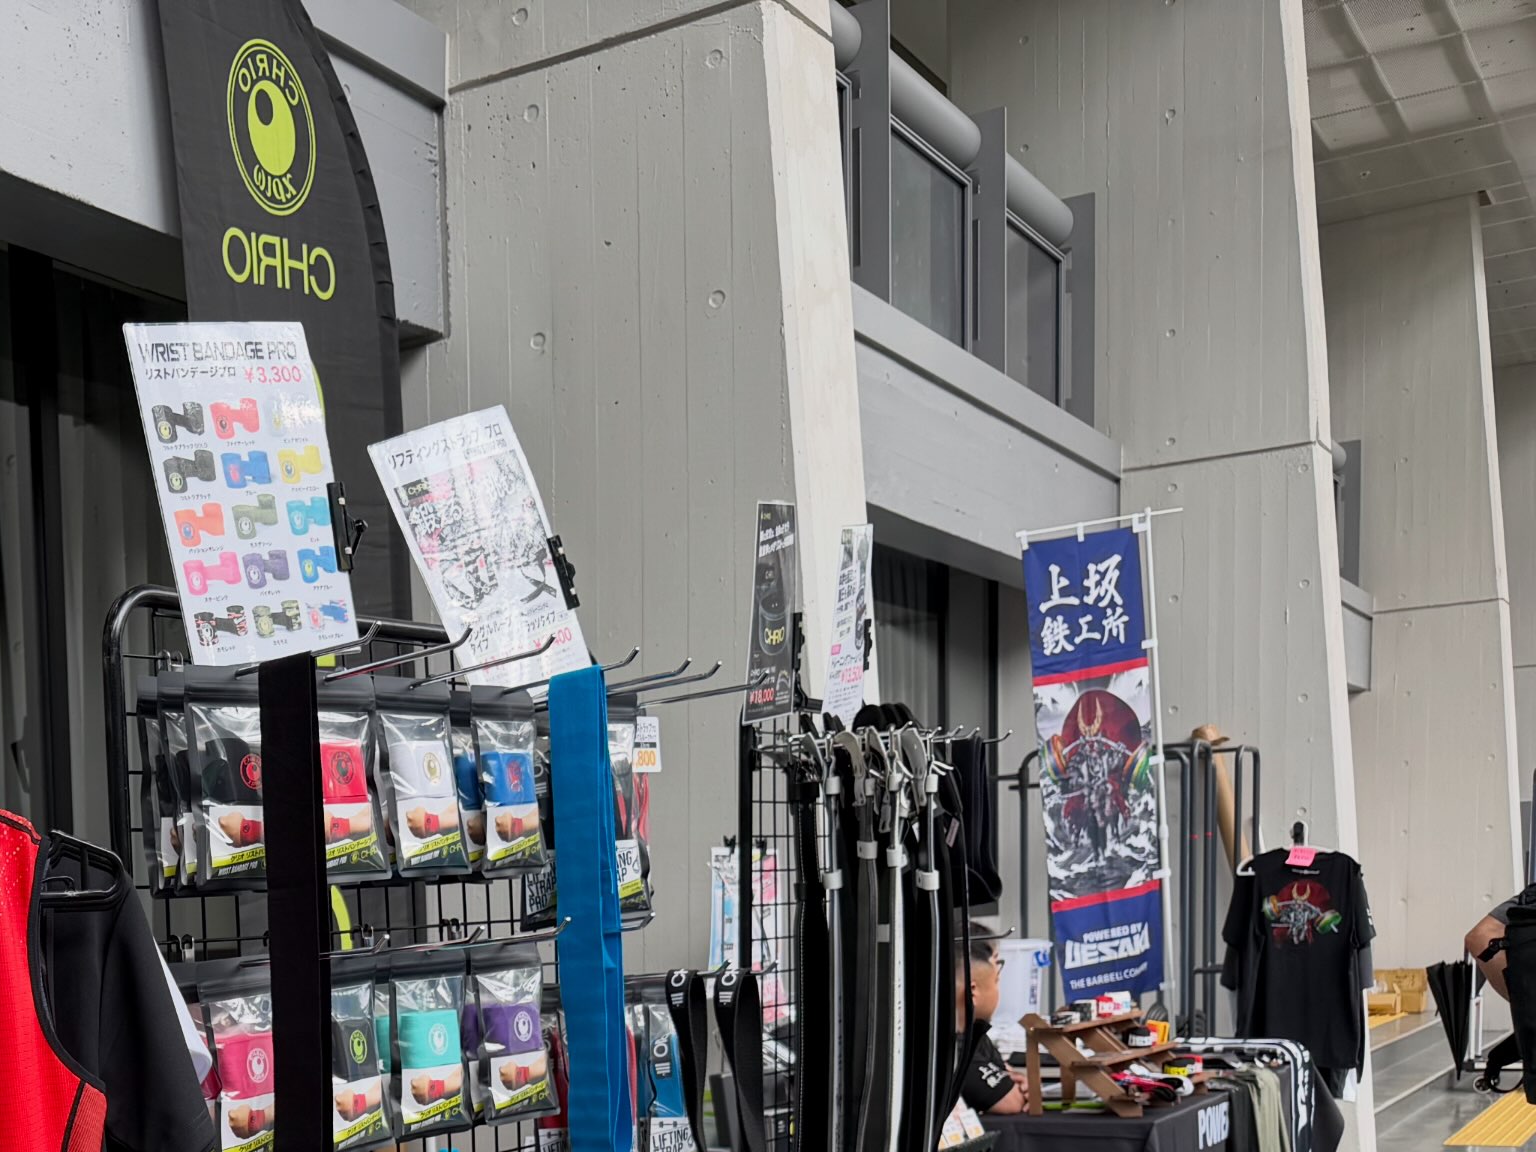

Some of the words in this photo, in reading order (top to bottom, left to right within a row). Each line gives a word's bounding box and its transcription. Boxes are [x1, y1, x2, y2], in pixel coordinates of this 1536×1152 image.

[138, 342, 188, 363] WRIST
[193, 341, 265, 362] BANDAGE
[268, 341, 298, 360] PRO
[1039, 553, 1124, 614] 上坂
[1040, 606, 1130, 657] 鉄工所
[652, 1128, 689, 1150] LIFTING
